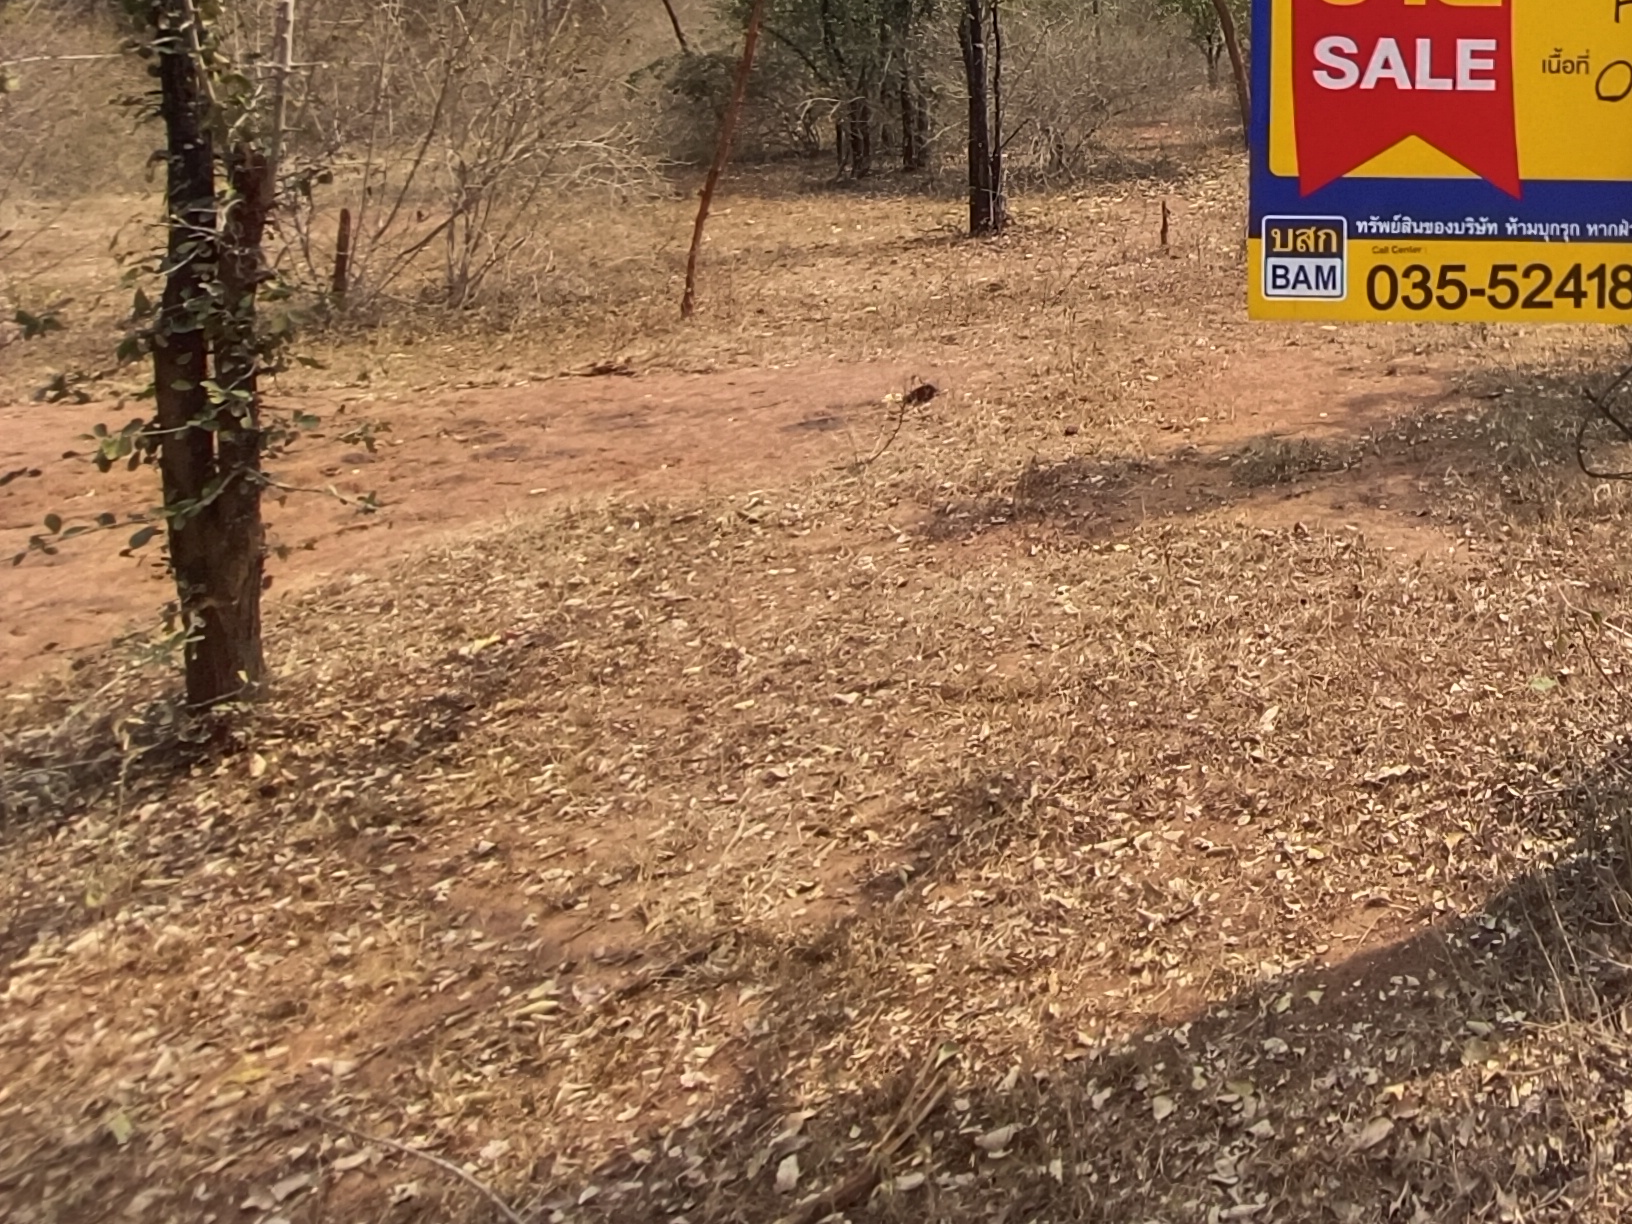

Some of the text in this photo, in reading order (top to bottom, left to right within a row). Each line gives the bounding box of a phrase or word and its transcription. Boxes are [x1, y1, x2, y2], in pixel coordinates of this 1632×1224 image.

[1312, 36, 1497, 91] SALE
[1541, 48, 1590, 75] เนื้อที่
[1271, 226, 1337, 254] บสก
[1355, 214, 1498, 236] ทรัพย์สินของบริษัท
[1506, 218, 1580, 242] ห้ามบุกรุก
[1272, 265, 1338, 291] BAM
